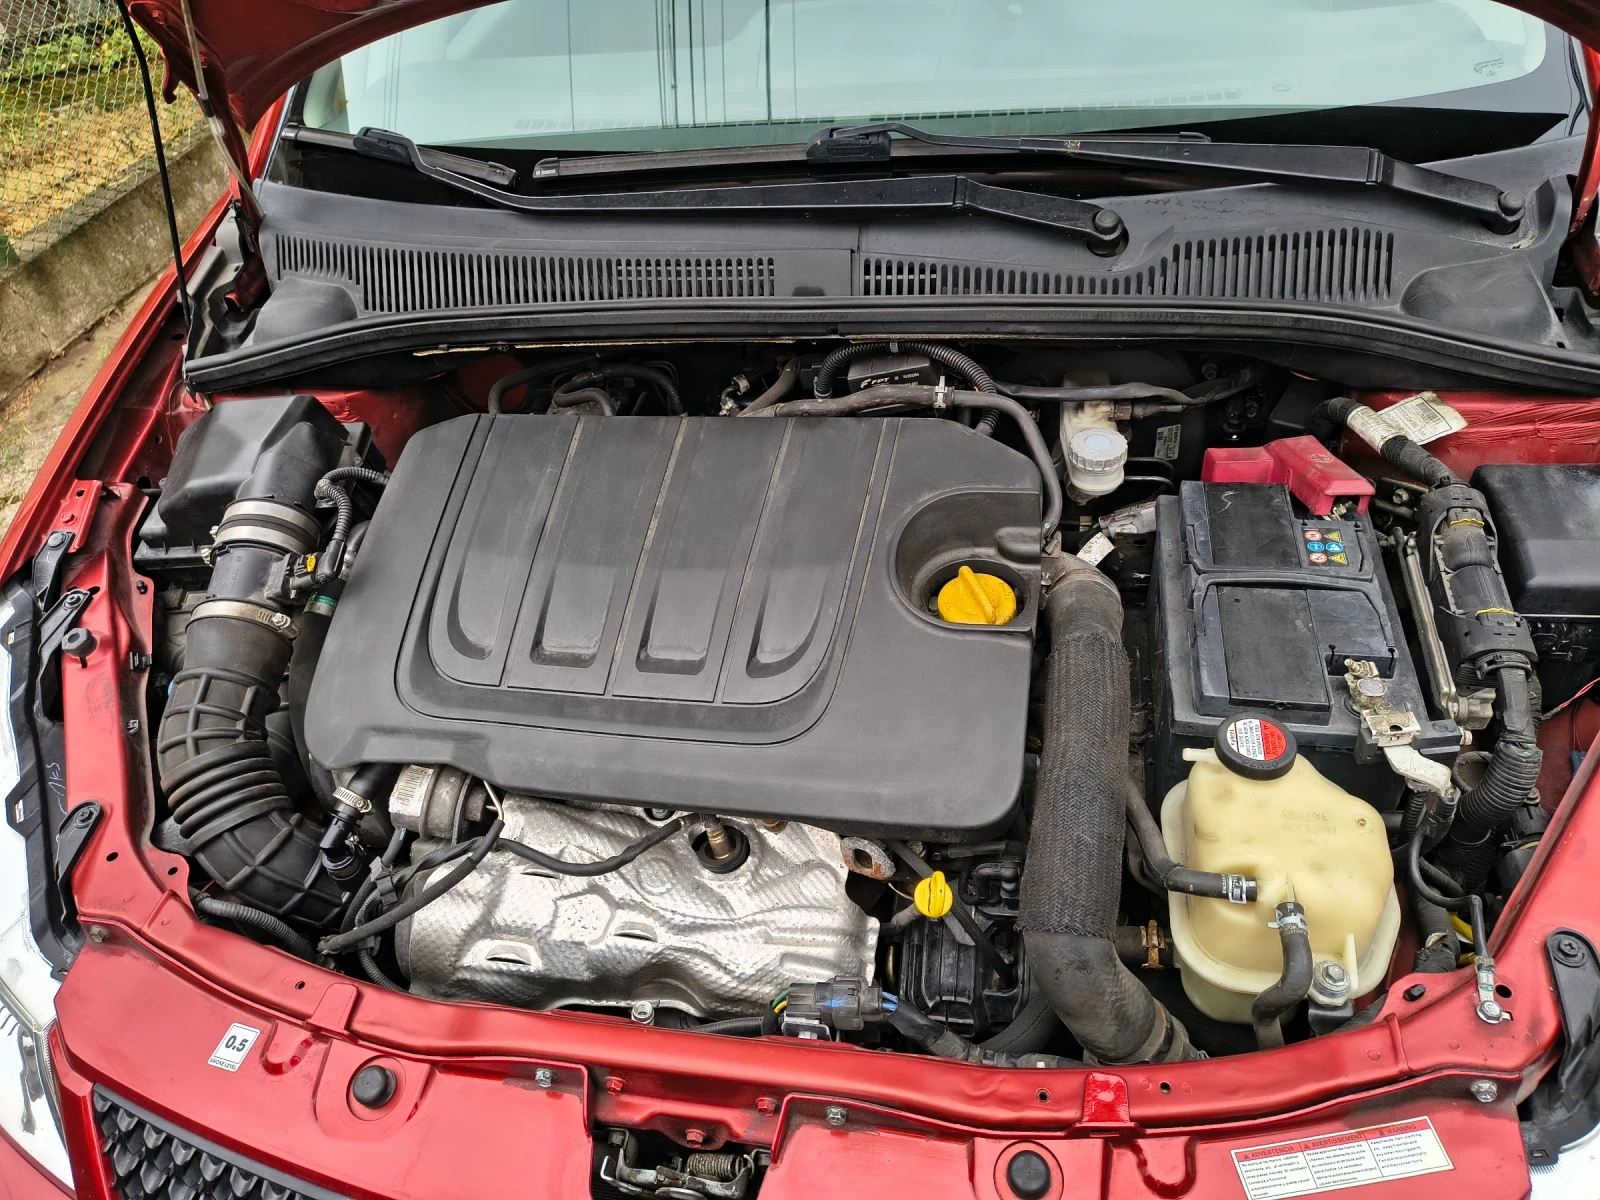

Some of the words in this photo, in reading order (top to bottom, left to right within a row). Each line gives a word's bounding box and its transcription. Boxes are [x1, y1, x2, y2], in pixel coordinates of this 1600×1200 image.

[1241, 759, 1279, 769] DENSO
[225, 1035, 248, 1052] 0.5
[1386, 1124, 1416, 1133] WARNING
[1312, 1134, 1363, 1147] AVERTISSEMENT
[1251, 1146, 1294, 1157] ADVERTENCIA
